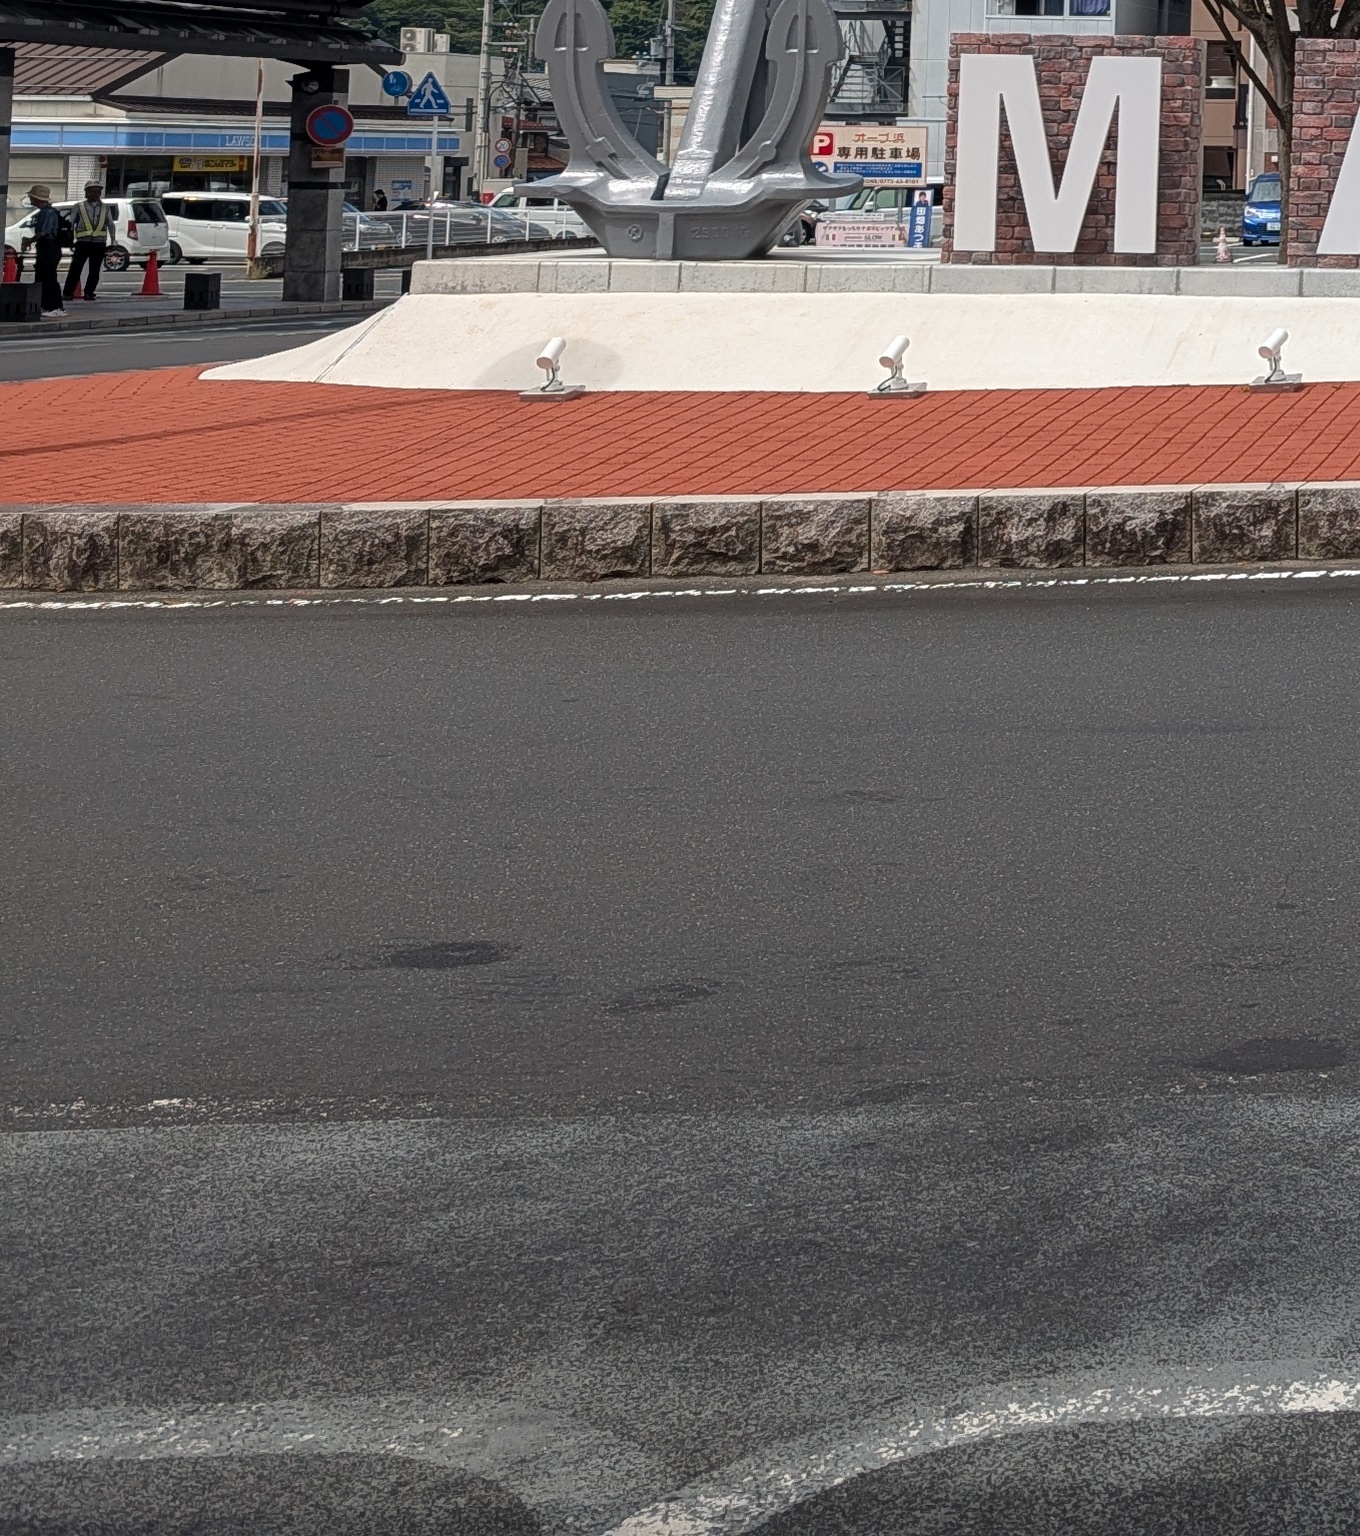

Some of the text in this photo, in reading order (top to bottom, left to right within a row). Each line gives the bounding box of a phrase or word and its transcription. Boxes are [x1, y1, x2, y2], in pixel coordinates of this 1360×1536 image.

[812, 135, 831, 154] P
[836, 146, 921, 160] 専用駐車場
